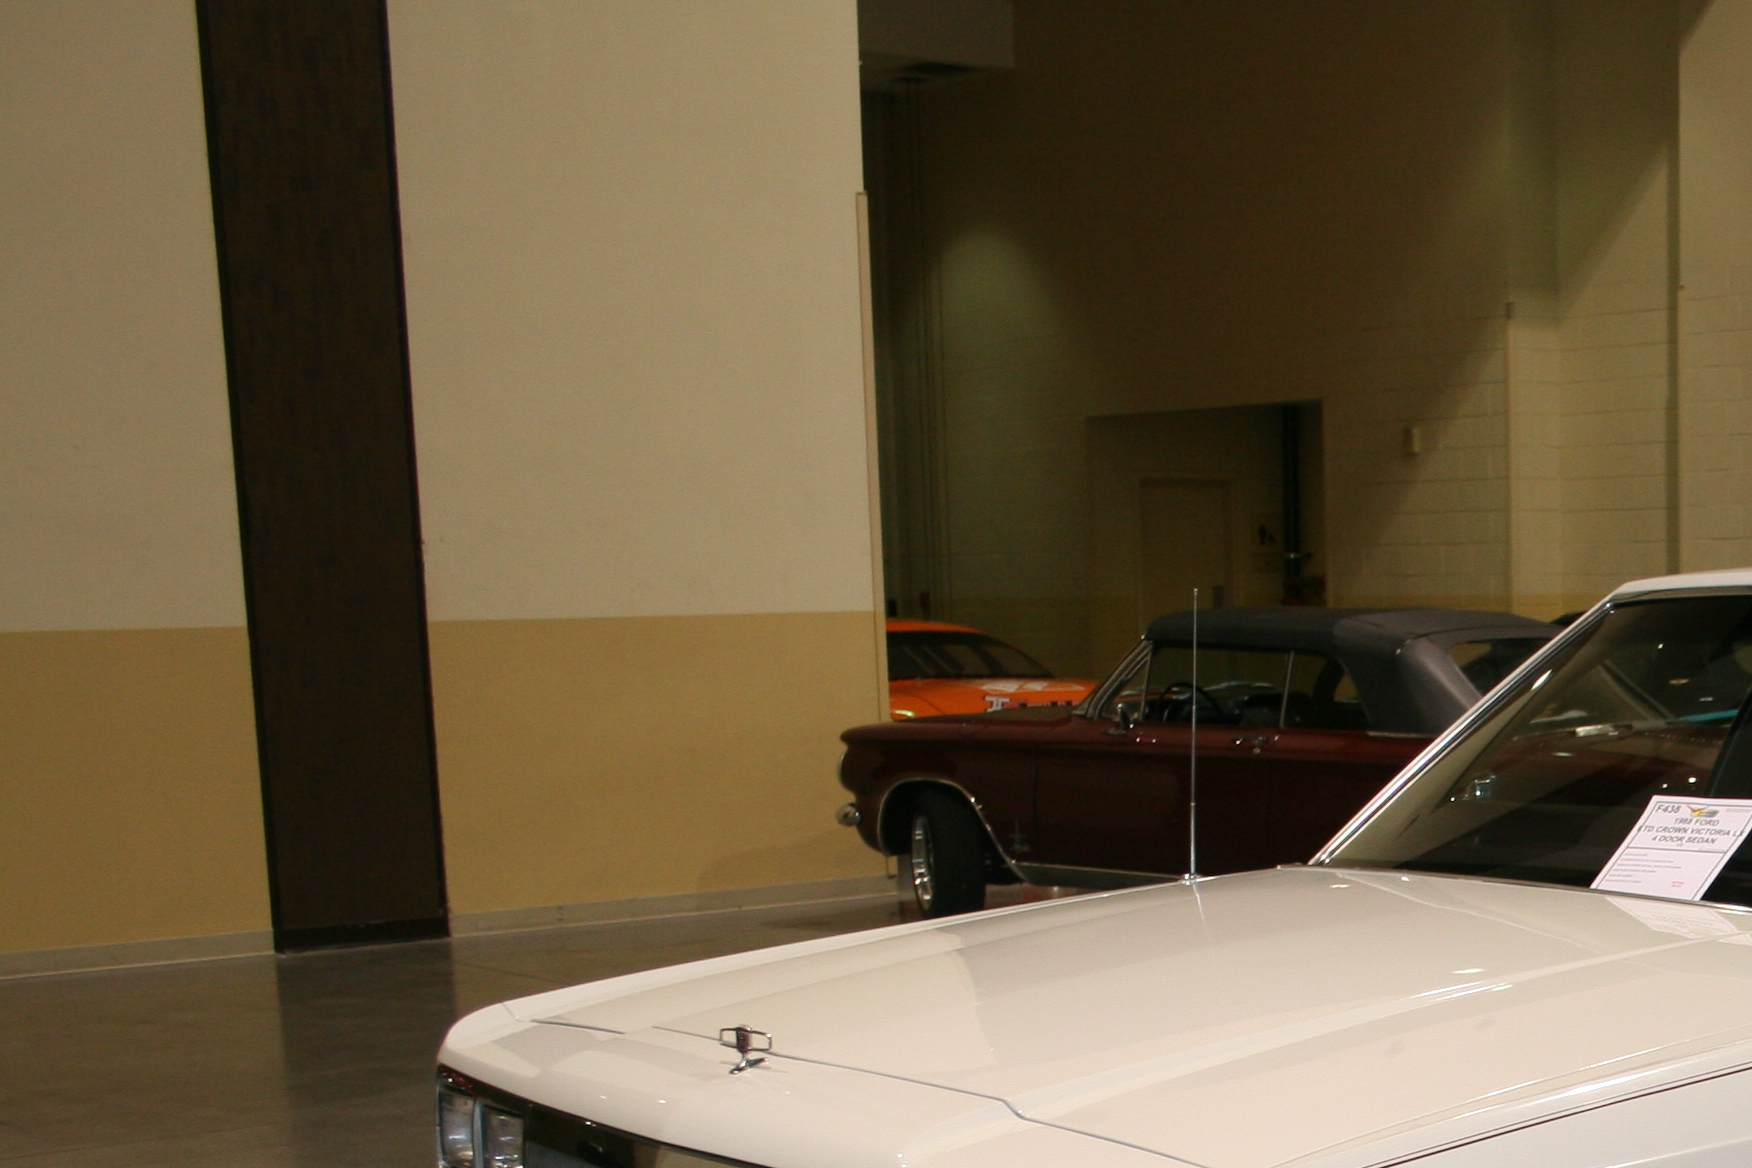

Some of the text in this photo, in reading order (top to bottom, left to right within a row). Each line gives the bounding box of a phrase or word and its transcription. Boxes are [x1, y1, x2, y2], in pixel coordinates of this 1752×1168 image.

[1694, 818, 1720, 827] FORD
[1655, 826, 1689, 834] CROWN
[1690, 827, 1730, 837] VICTORIA
[1658, 836, 1685, 844] DOOR
[1685, 836, 1717, 845] SEDAN
